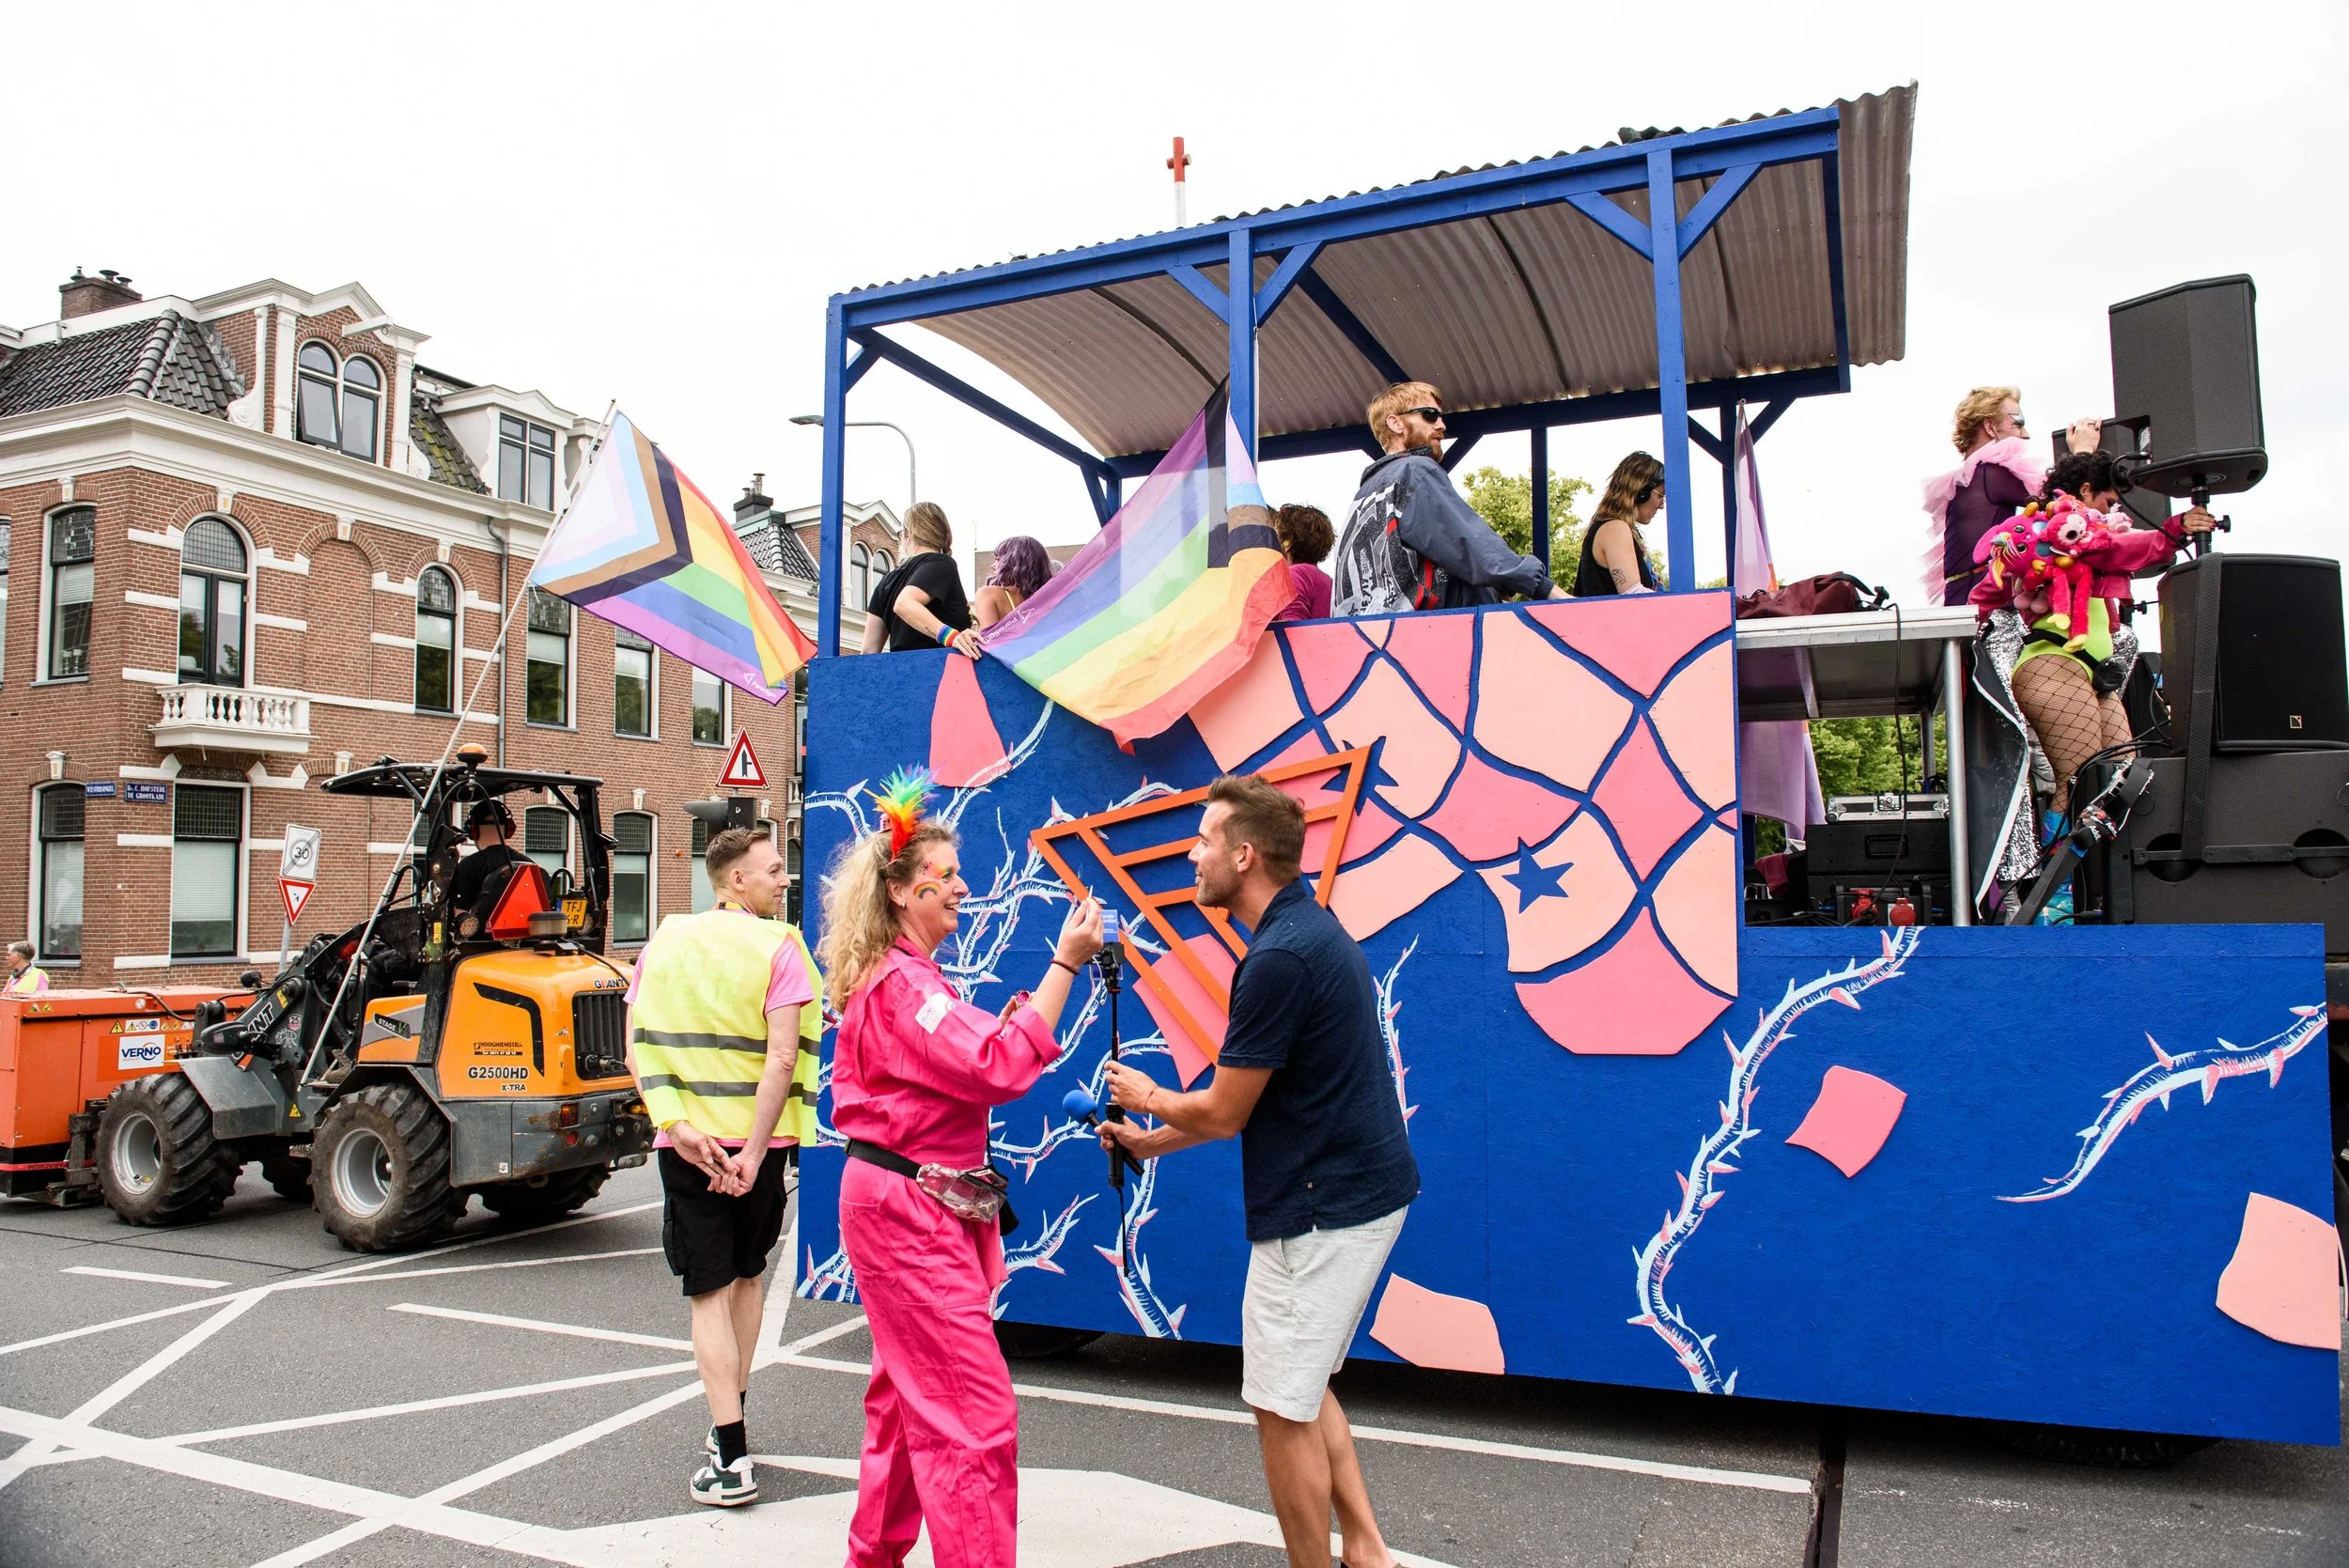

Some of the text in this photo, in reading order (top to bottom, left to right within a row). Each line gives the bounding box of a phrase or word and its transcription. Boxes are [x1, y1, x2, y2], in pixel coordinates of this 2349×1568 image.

[294, 846, 309, 860] 30
[567, 901, 583, 912] TFJ
[594, 979, 626, 989] GIANT
[290, 1017, 300, 1025] 25
[378, 1017, 397, 1032] STAGE
[121, 1046, 162, 1059] VERNO
[468, 1066, 529, 1079] G2500HD
[501, 1083, 526, 1092] X-TRA
